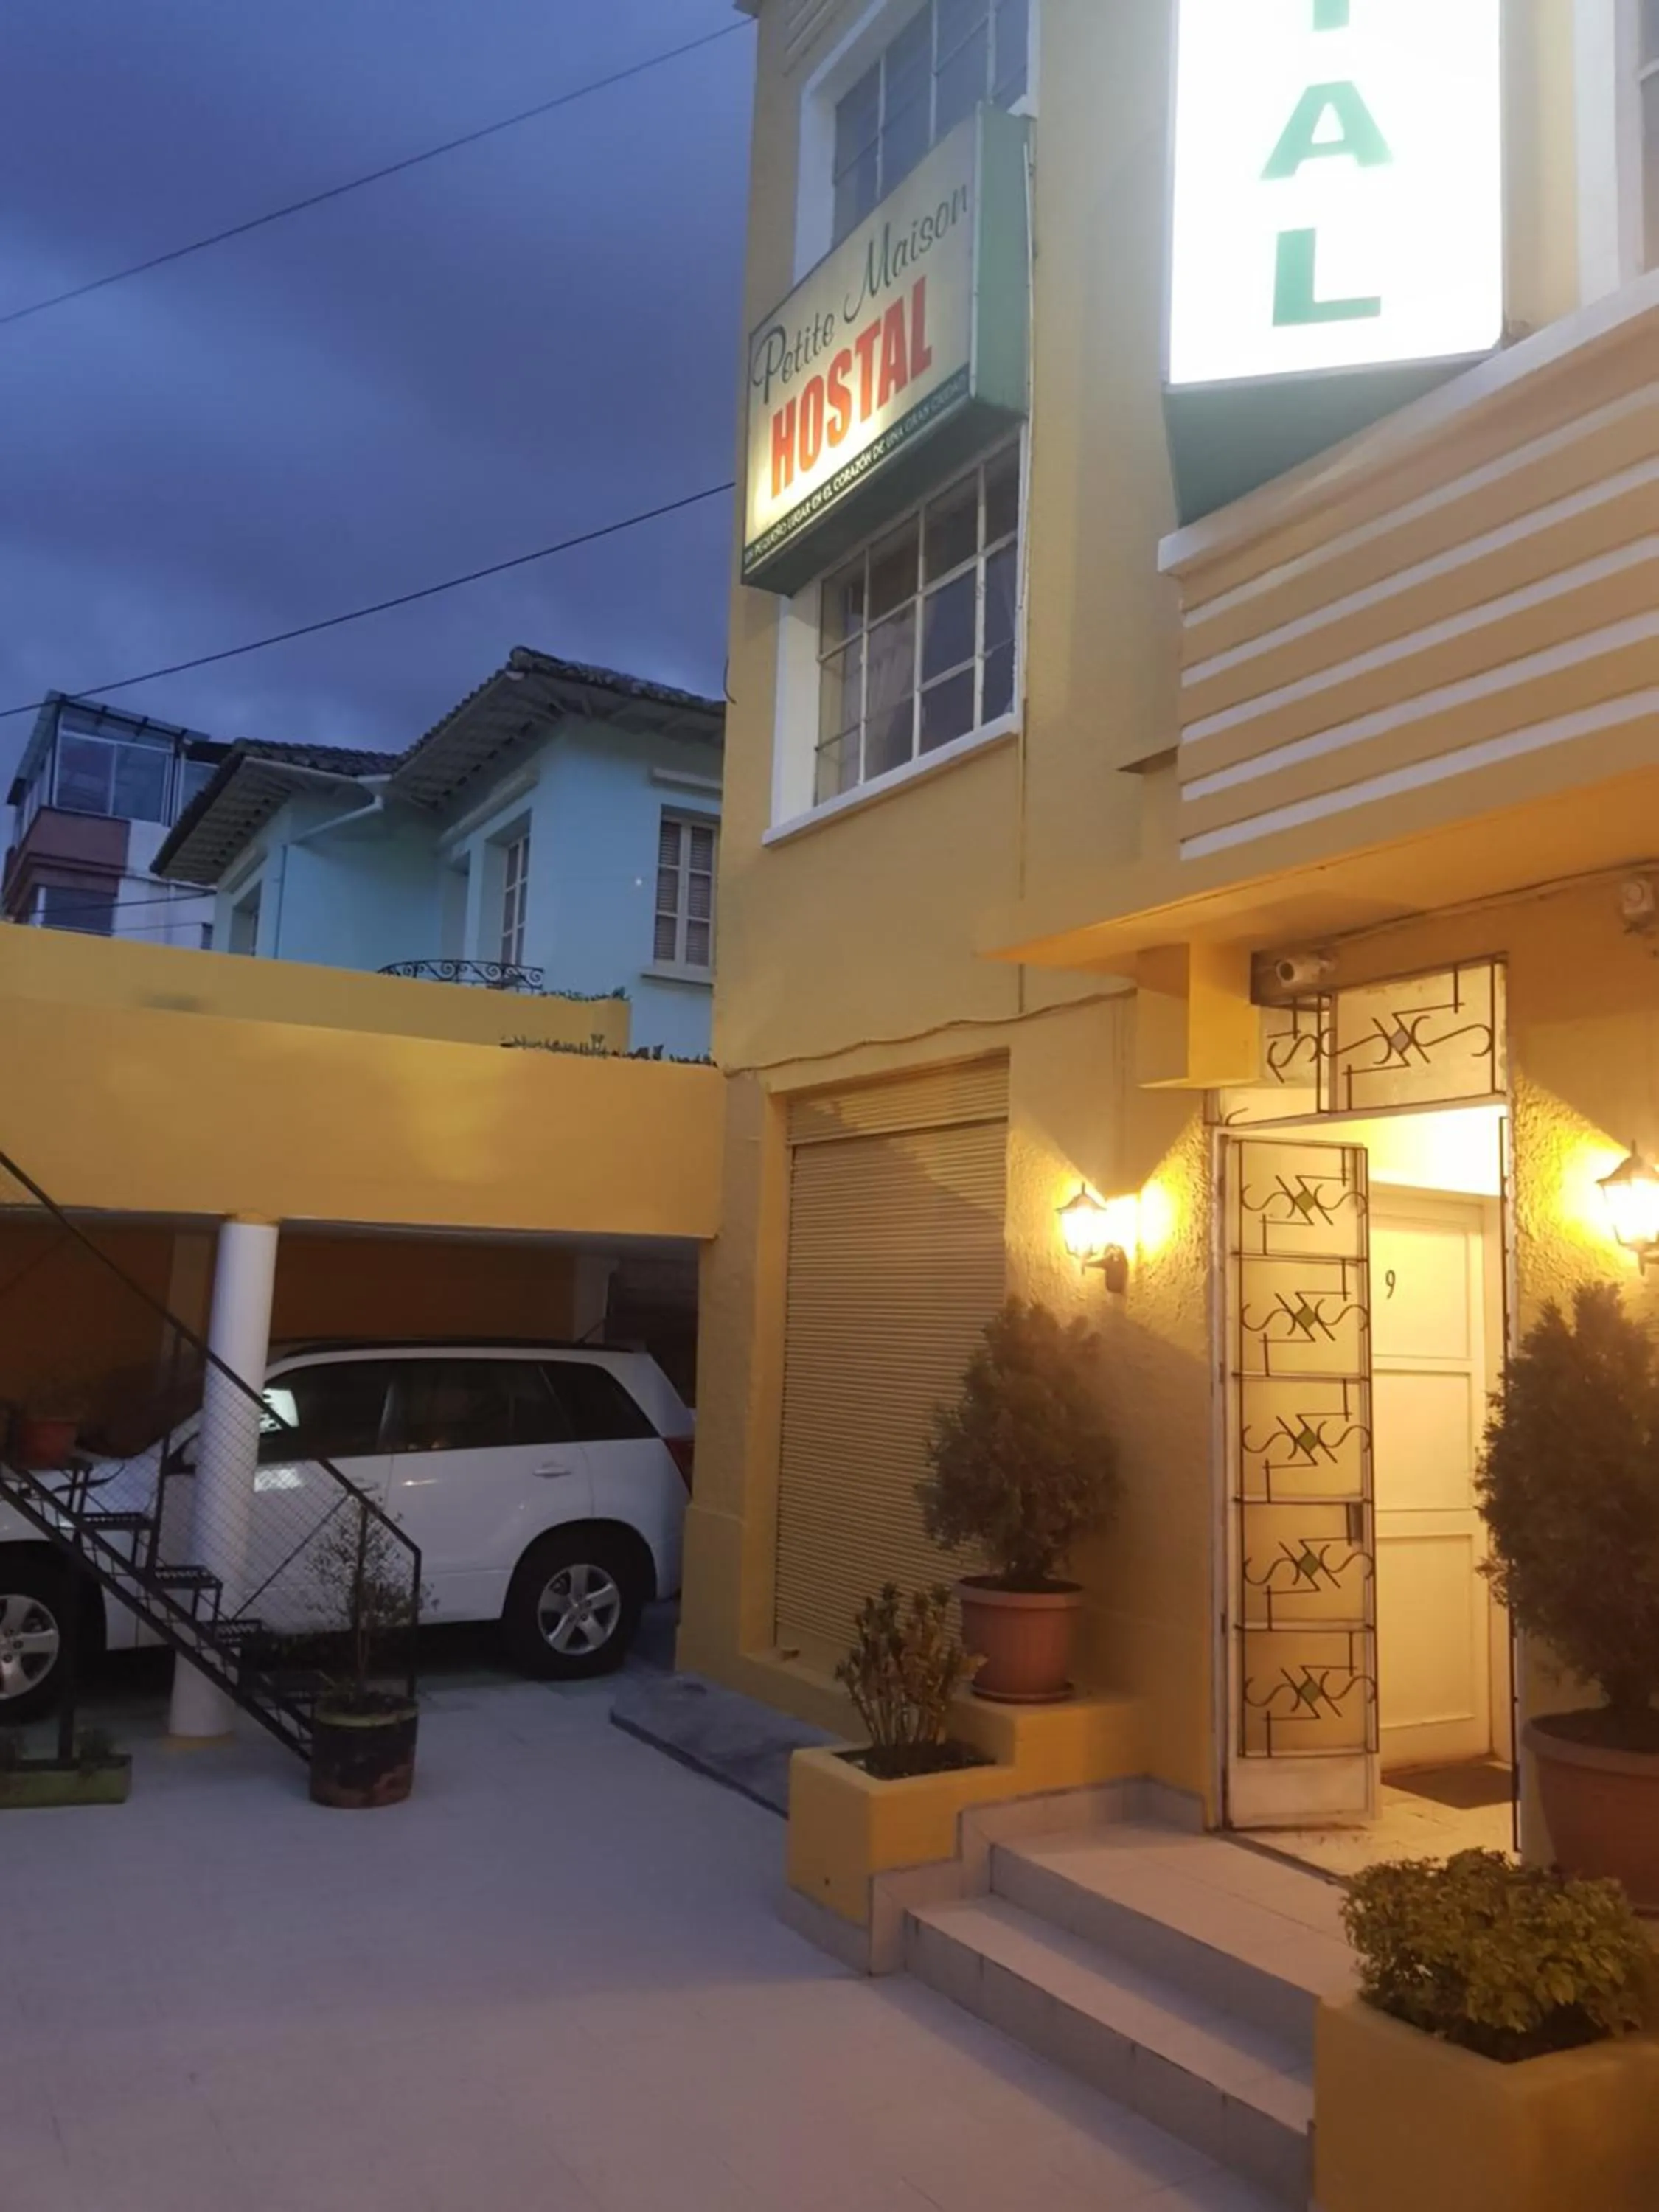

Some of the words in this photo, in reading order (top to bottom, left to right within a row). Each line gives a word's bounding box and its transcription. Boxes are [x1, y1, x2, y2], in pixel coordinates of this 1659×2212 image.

[751, 312, 835, 406] Petite
[844, 184, 967, 324] Maison
[771, 274, 933, 500] HOSTAL
[1385, 1269, 1396, 1300] 9
